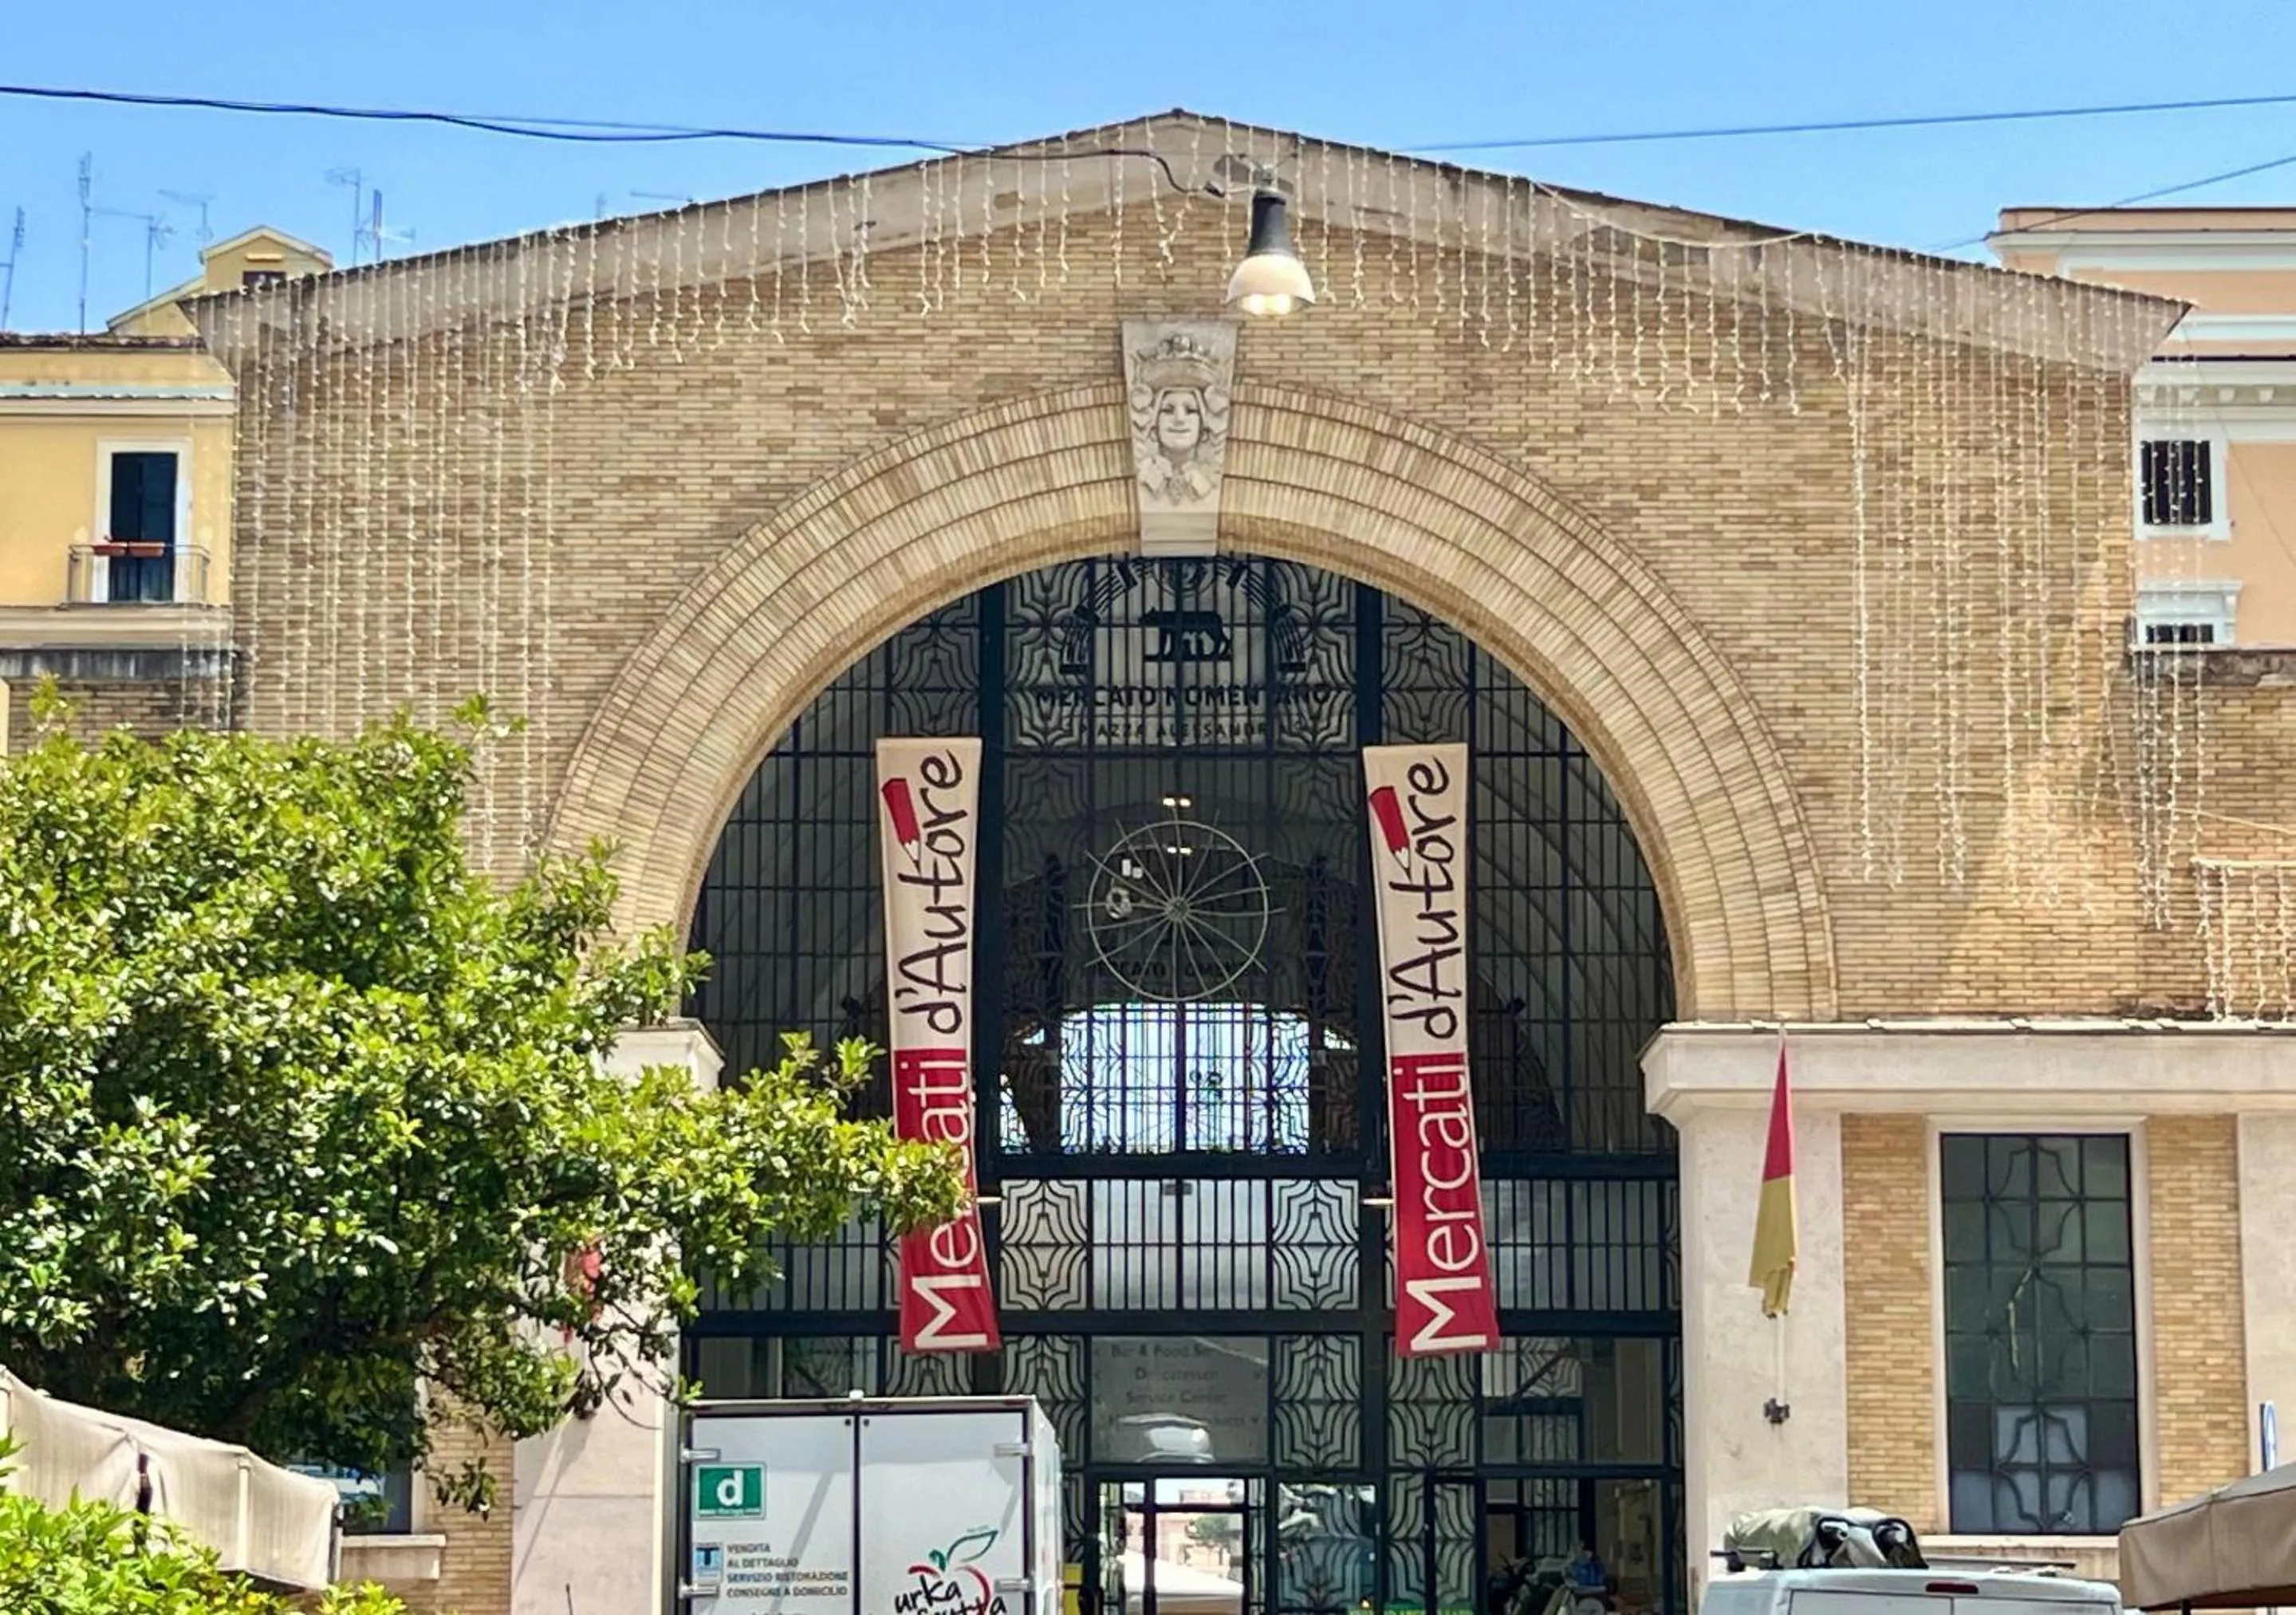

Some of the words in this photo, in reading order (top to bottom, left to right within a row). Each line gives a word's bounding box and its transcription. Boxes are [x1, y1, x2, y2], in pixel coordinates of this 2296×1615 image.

[1165, 684, 1329, 707] NOMENANO
[896, 749, 968, 1034] d'Autore
[1388, 757, 1463, 1039] d'Autore
[900, 1060, 987, 1349] Meati
[1392, 1065, 1487, 1351] Mercati
[717, 1469, 744, 1506] d
[696, 1546, 720, 1566] T
[727, 1543, 771, 1554] VENDITA
[727, 1559, 740, 1568] AL
[742, 1558, 799, 1569] DETTAGLIO
[727, 1573, 773, 1583] SERVIZIO
[775, 1571, 849, 1582] RISTORAZIONE
[784, 1587, 790, 1597] A
[793, 1585, 848, 1597] DOMICILIO
[894, 1574, 963, 1614] urka
